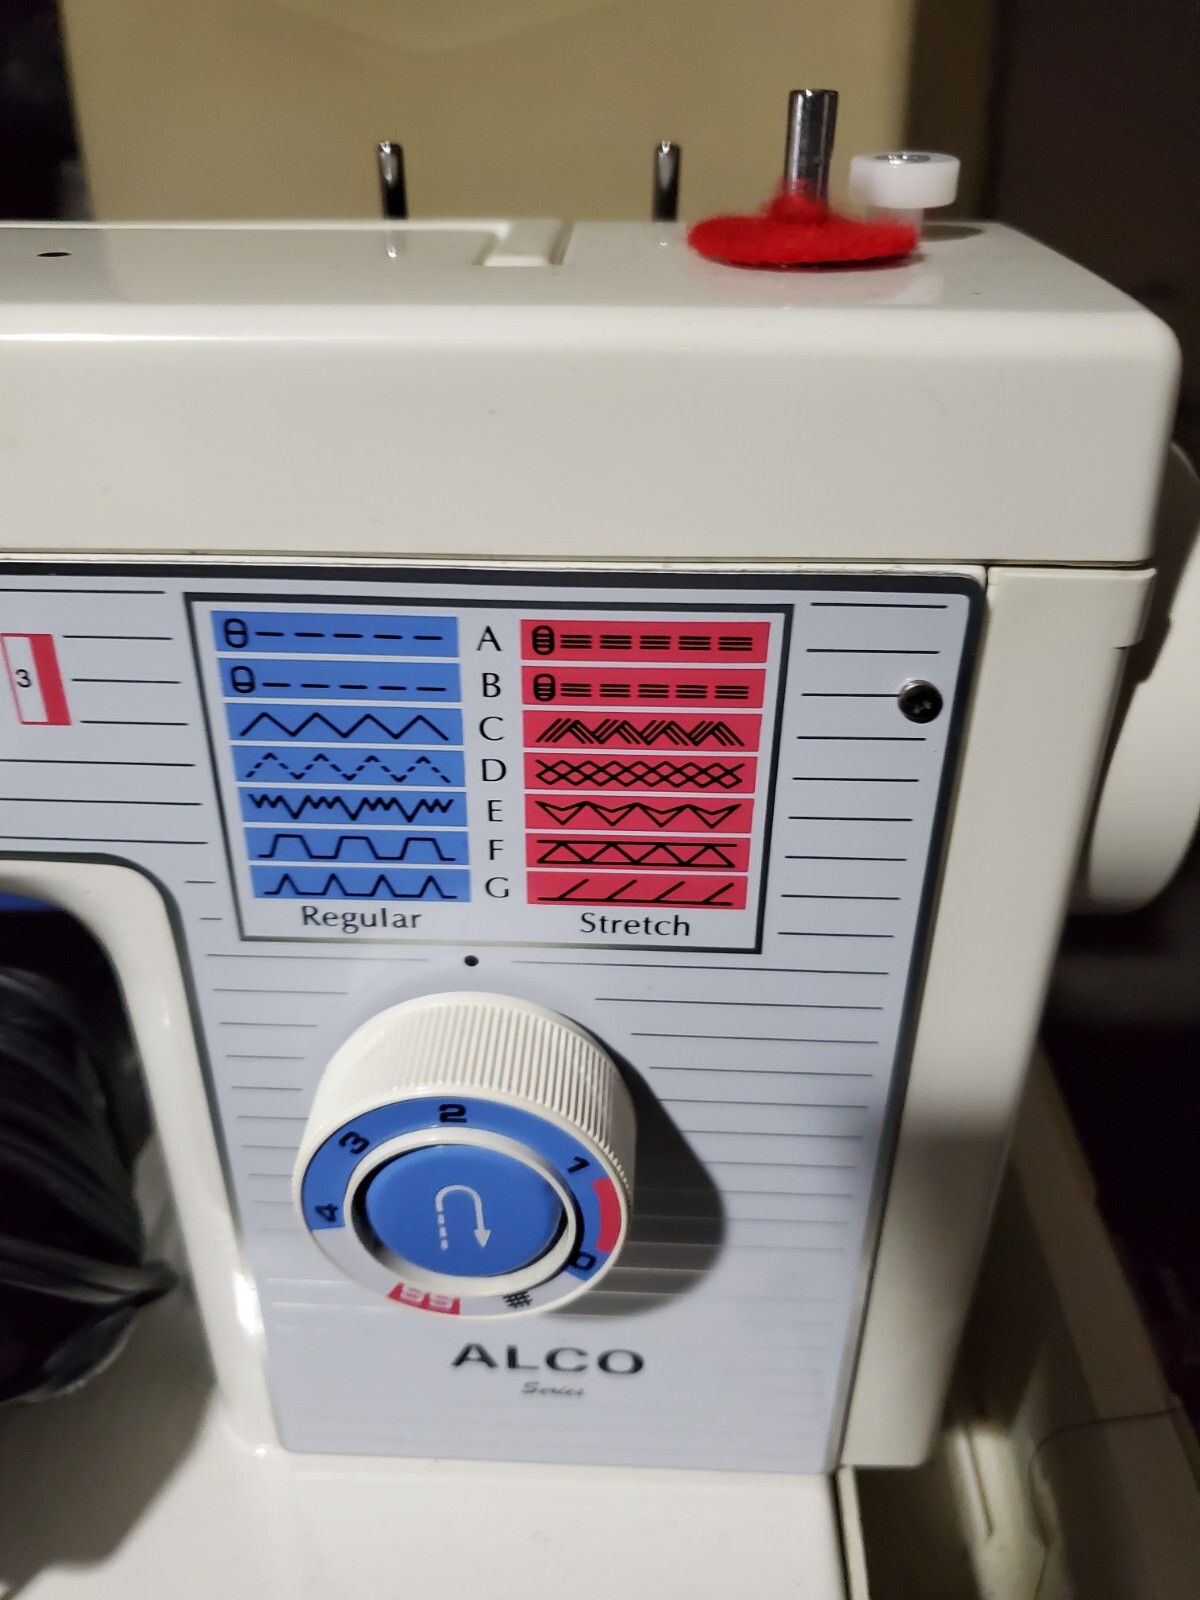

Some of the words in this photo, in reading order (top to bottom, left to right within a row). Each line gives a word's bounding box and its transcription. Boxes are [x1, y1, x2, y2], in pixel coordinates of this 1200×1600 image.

[476, 625, 502, 652] A
[15, 668, 32, 689] 3
[481, 672, 502, 698] B
[479, 716, 504, 741] C
[481, 759, 507, 782] D
[487, 799, 504, 822] E
[489, 839, 504, 861] F
[485, 876, 509, 898] G
[301, 904, 423, 934] Regular
[579, 911, 692, 937] Stretch
[438, 1103, 468, 1124] 2
[338, 1130, 370, 1155] 3
[566, 1156, 591, 1173] 1
[314, 1203, 339, 1223] 4
[450, 1342, 645, 1375] ALCO
